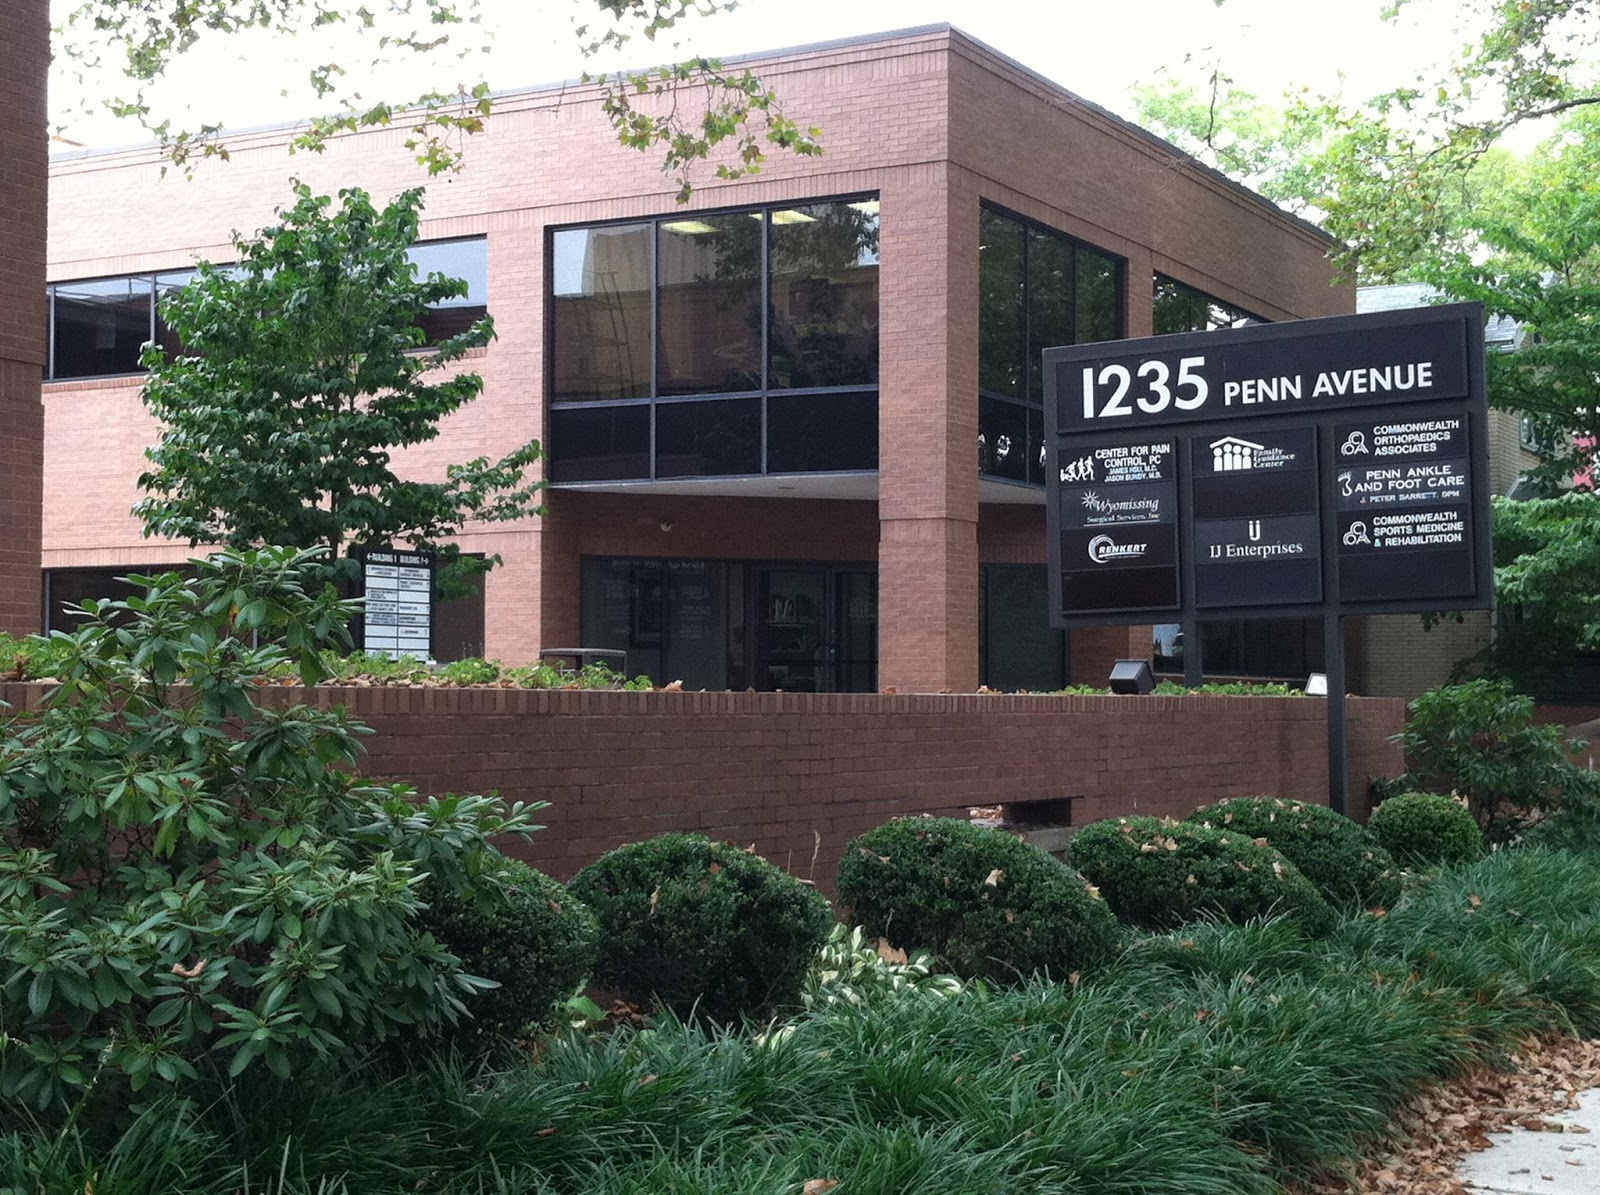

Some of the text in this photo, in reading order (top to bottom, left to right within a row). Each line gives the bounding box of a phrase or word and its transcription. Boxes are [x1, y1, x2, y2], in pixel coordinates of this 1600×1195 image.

[1082, 355, 1432, 418] 1235 PENN AVENUE
[1373, 420, 1459, 435] COMMONWEALTH
[1374, 431, 1450, 445] ORTHOPAEDICS
[1095, 443, 1170, 459] CENTER FOR PAIN
[1374, 443, 1437, 456] ASSOCIATES
[1149, 455, 1161, 464] PC
[1366, 465, 1451, 480] PENN ANKLE
[1354, 475, 1465, 492] AND FOOT CARE
[1369, 494, 1396, 503] PETER
[1441, 490, 1460, 498] DPM
[1096, 497, 1159, 514] Wyomissing
[1373, 511, 1457, 526] COMMONWEALTH
[1373, 521, 1464, 537] SPORTS MEDICINE
[1374, 533, 1461, 547] & REHABILITATION
[1099, 543, 1147, 554] RENKERT
[1226, 541, 1303, 559] Enterprises
